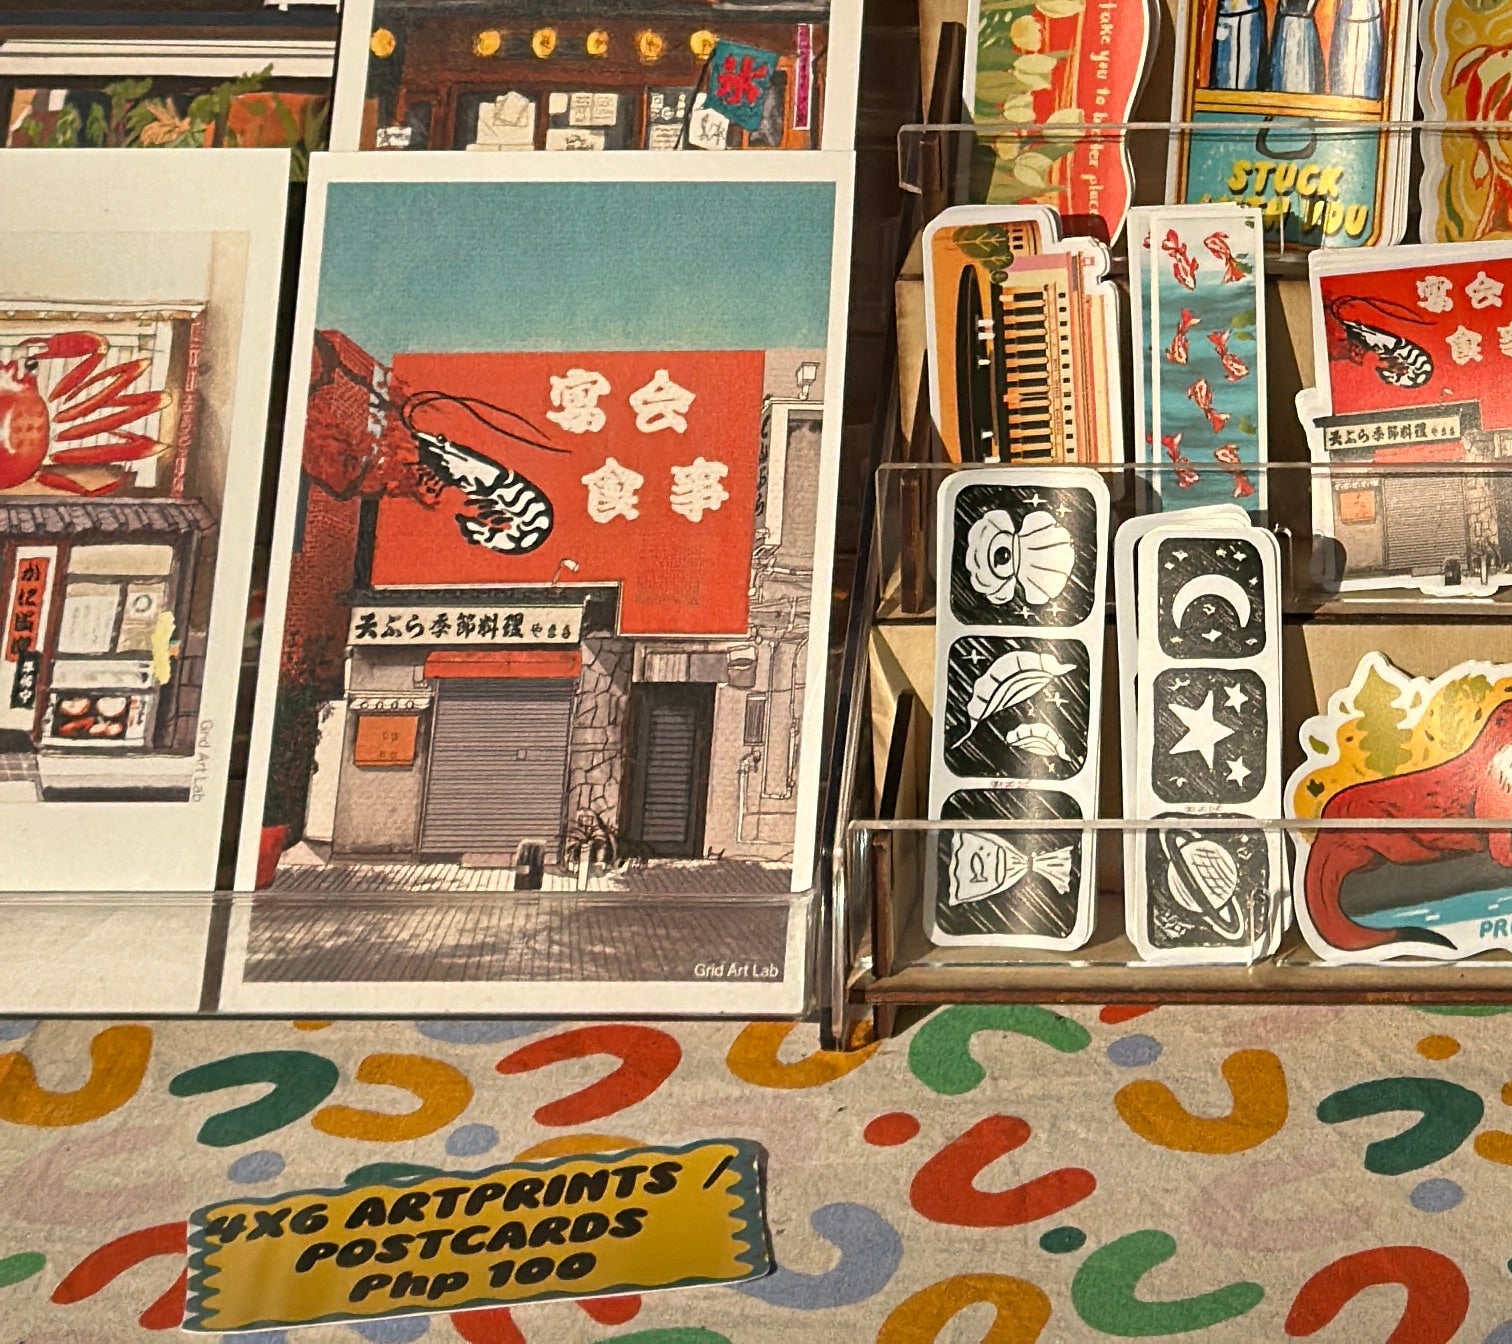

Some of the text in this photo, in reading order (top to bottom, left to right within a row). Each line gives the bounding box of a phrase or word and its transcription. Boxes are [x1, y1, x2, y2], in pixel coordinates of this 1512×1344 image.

[1090, 50, 1111, 81] you
[1095, 88, 1112, 107] to
[1227, 159, 1344, 199] STUCK
[694, 962, 779, 978] Grid Art Lab
[205, 1203, 329, 1246] 4X6
[345, 1160, 684, 1231] ARTPRINTS
[294, 1207, 648, 1274] POSTCARDS
[348, 1251, 598, 1304] Php 100
